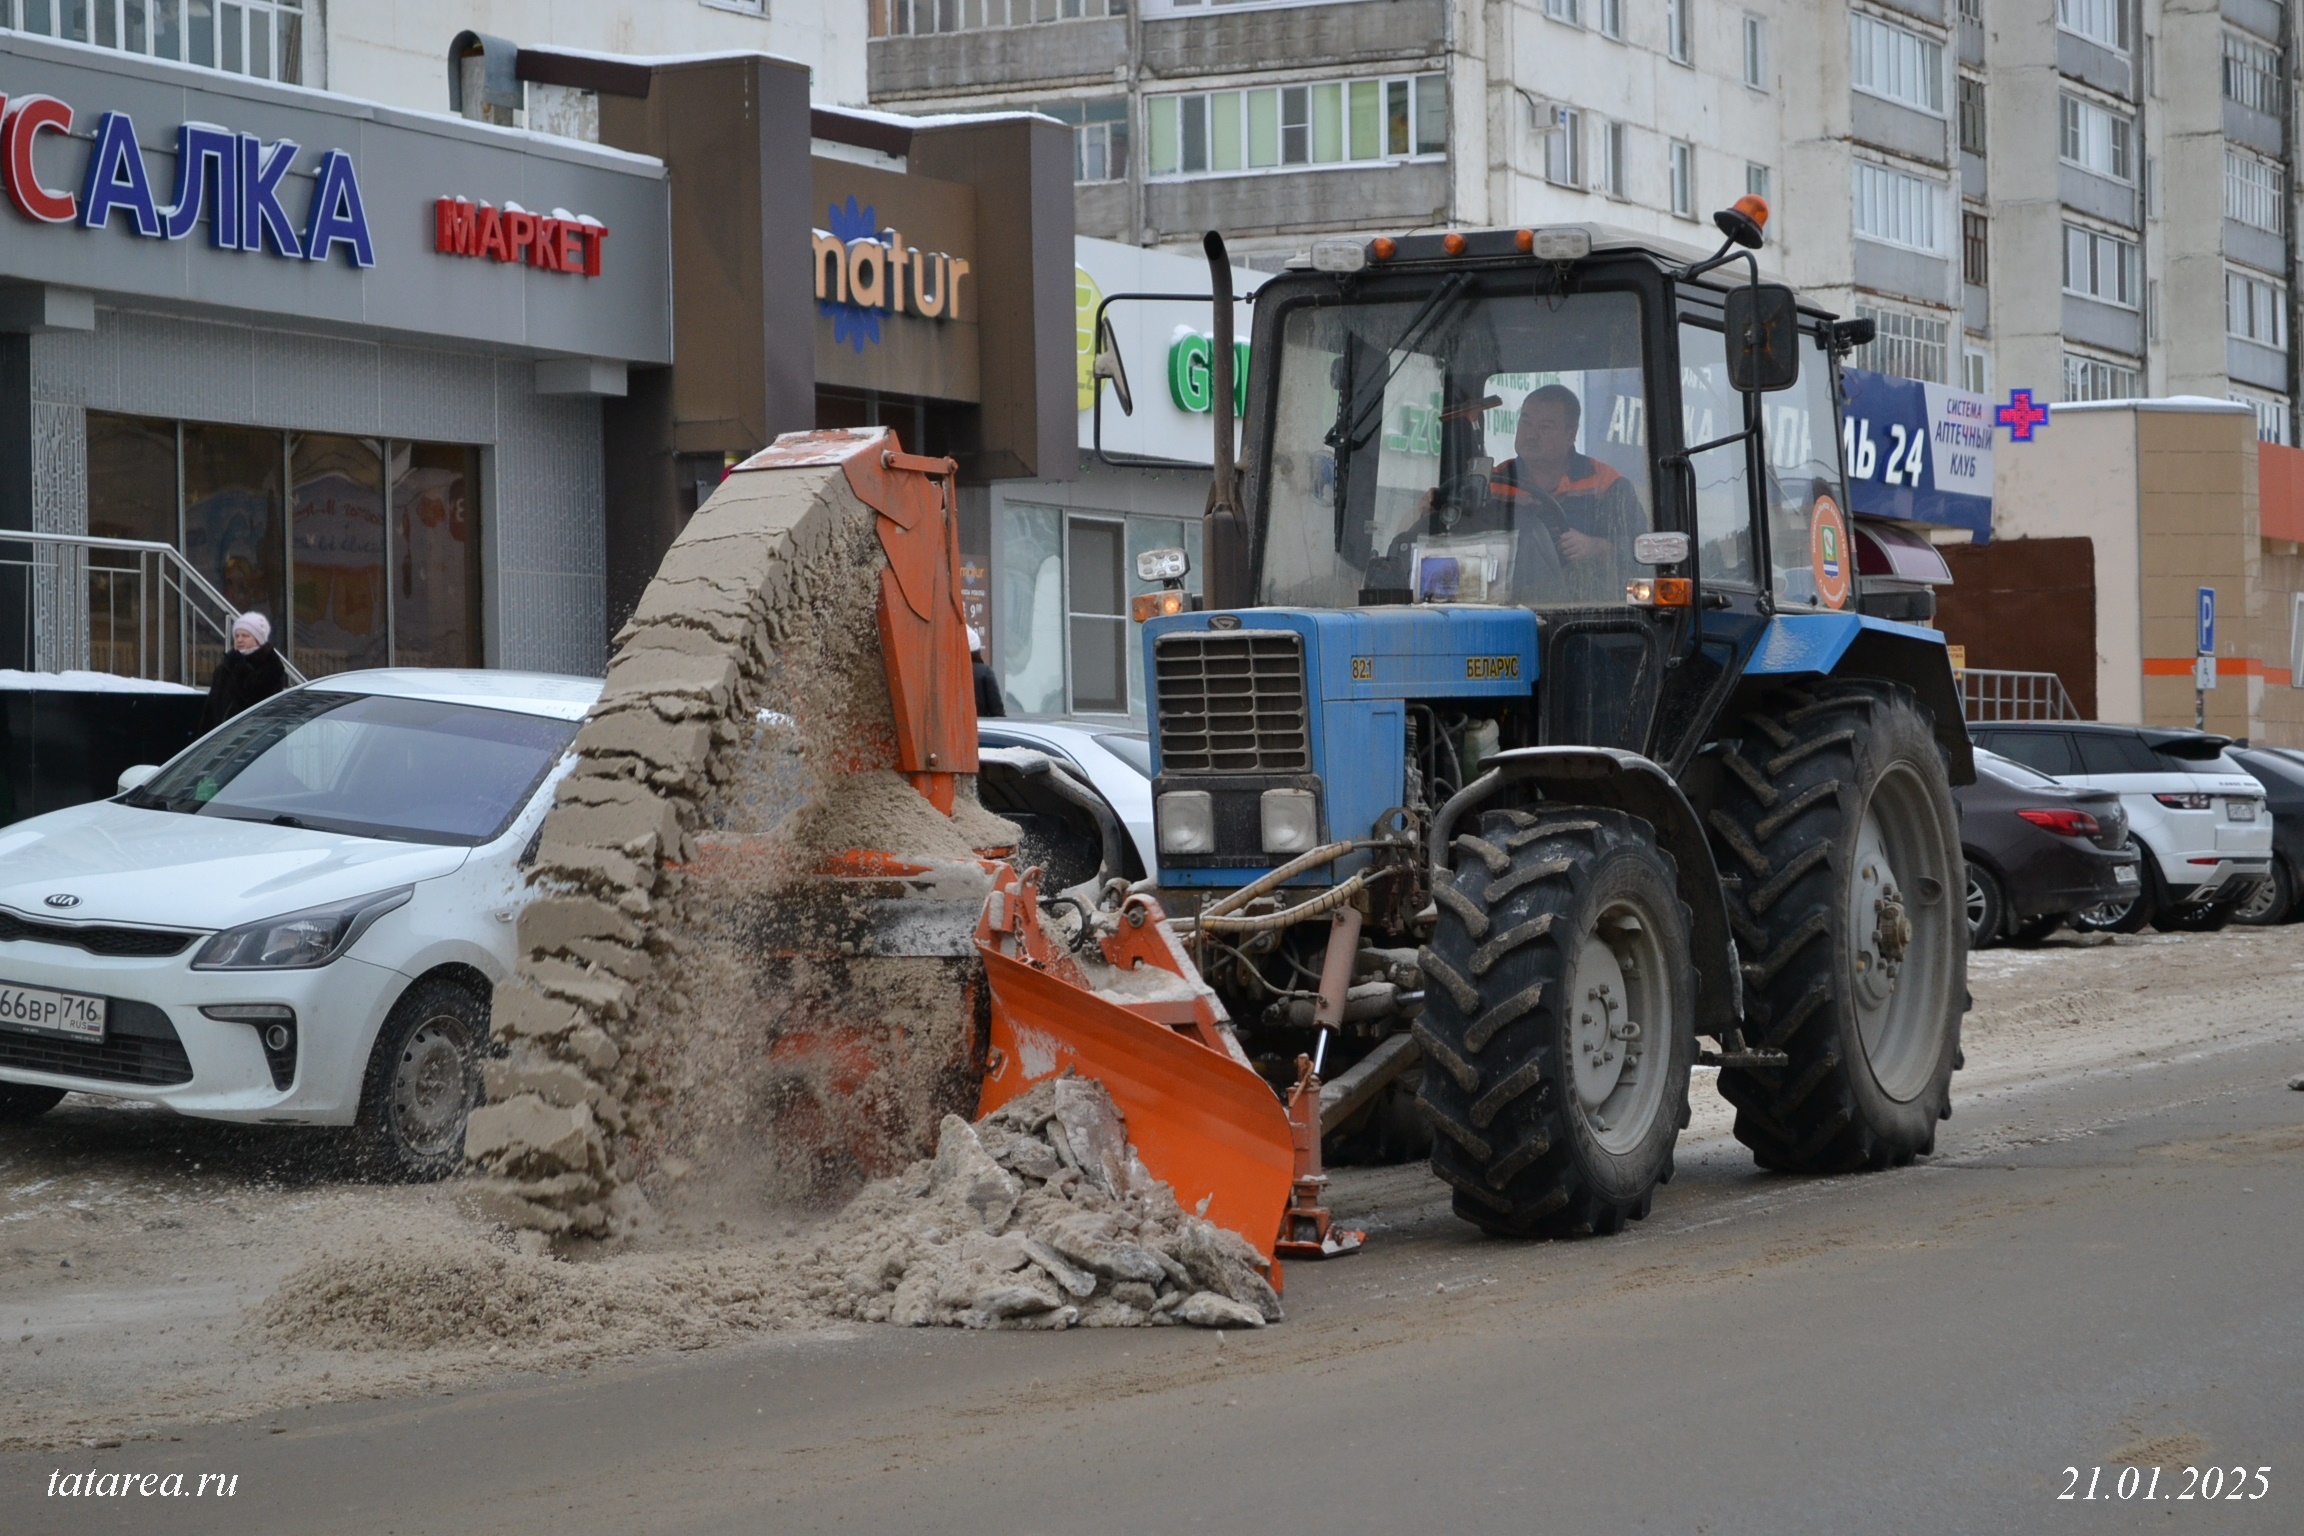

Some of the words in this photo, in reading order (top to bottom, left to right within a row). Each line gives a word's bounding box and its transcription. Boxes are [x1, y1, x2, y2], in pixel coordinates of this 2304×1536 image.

[0, 91, 376, 268] САЛКА
[435, 195, 608, 276] МАРКЕТ
[1946, 398, 1982, 420] СИСТЕМА
[1935, 420, 1993, 451] АПТЕЧНЫЙ
[1885, 423, 1924, 488] 24
[1950, 452, 1976, 478] КЛУБ
[1466, 656, 1519, 680] БЕЛАРУС
[49, 894, 75, 906] KIA
[63, 997, 97, 1021] 716
[69, 1021, 87, 1030] RUS
